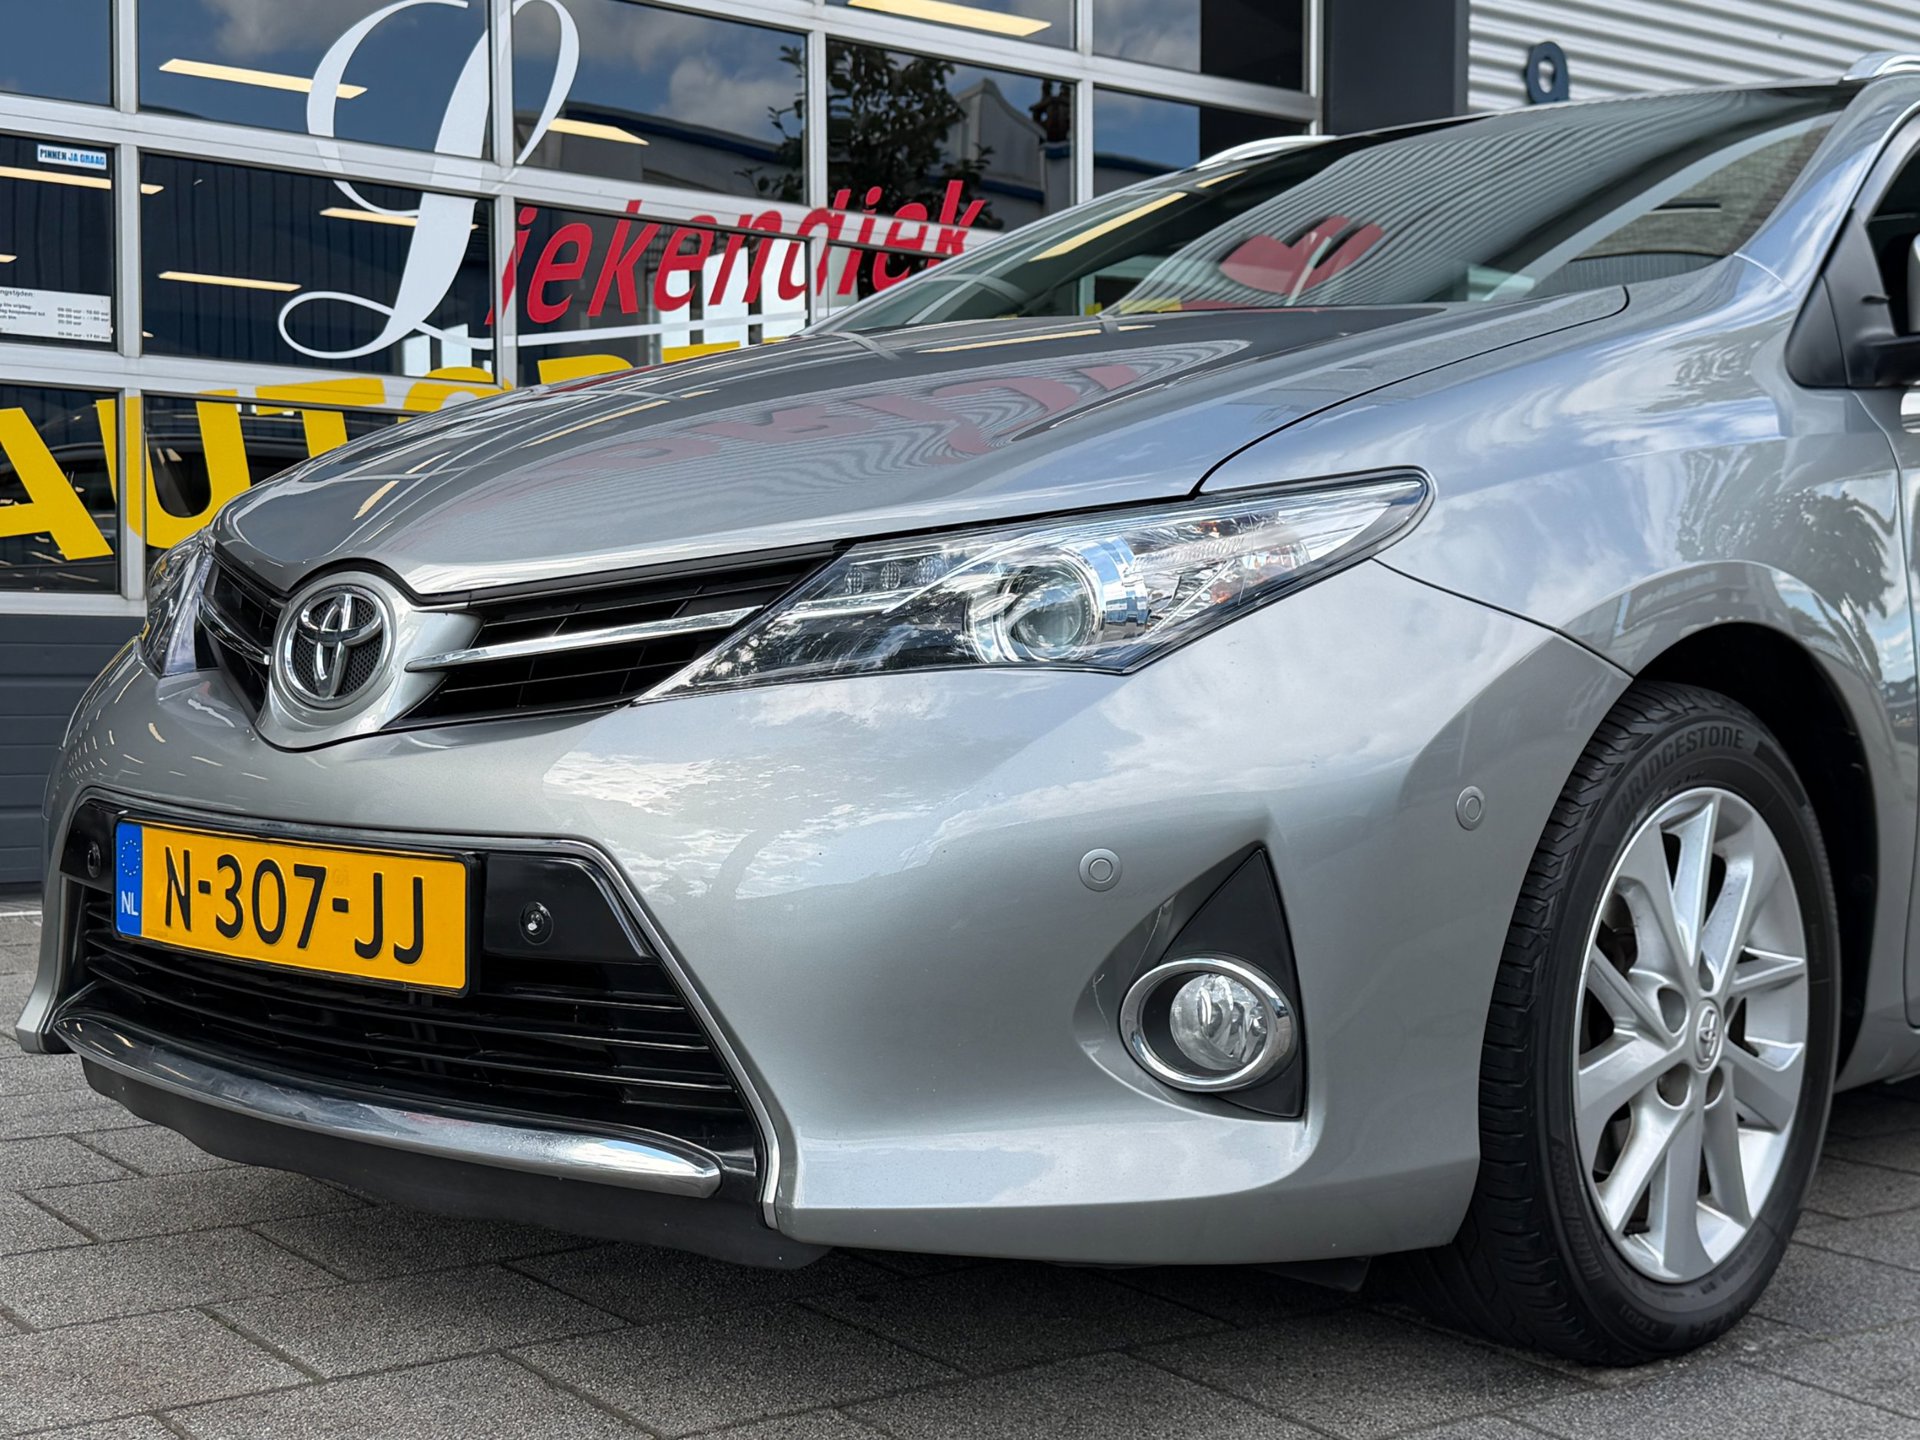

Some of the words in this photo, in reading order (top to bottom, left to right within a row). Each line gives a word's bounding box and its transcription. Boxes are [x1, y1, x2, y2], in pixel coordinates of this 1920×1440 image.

[68, 152, 79, 163] JA
[1614, 726, 1745, 823] BRIDGESTONE
[121, 890, 139, 916] NL
[164, 846, 424, 964] N-307-JJ
